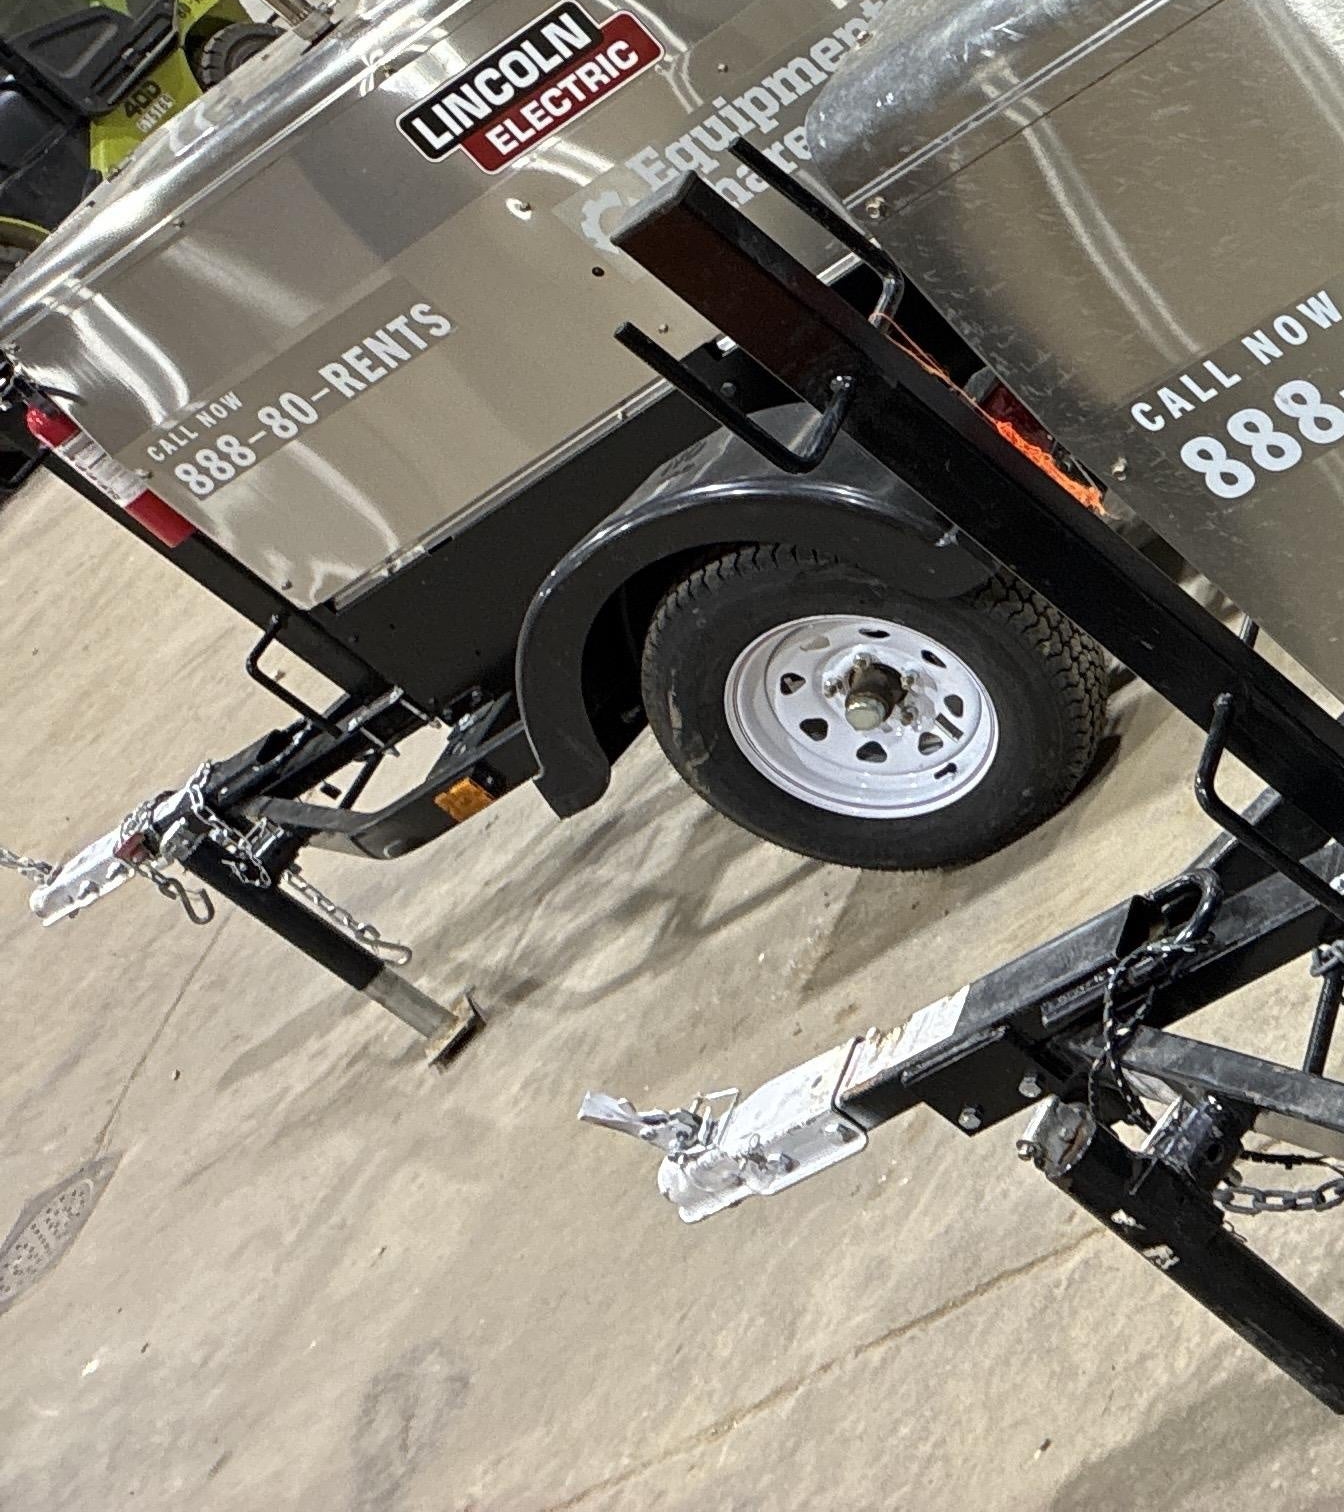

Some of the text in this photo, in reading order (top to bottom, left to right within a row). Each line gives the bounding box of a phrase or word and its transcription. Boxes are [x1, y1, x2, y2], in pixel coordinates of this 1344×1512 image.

[410, 13, 594, 152] LINCOLN
[486, 39, 641, 156] ELECTRIC
[713, 123, 813, 210] hare
[173, 301, 454, 499] 888-80-RENTS
[1129, 288, 1344, 433] CALL NOW
[147, 390, 243, 463] CALL NOW
